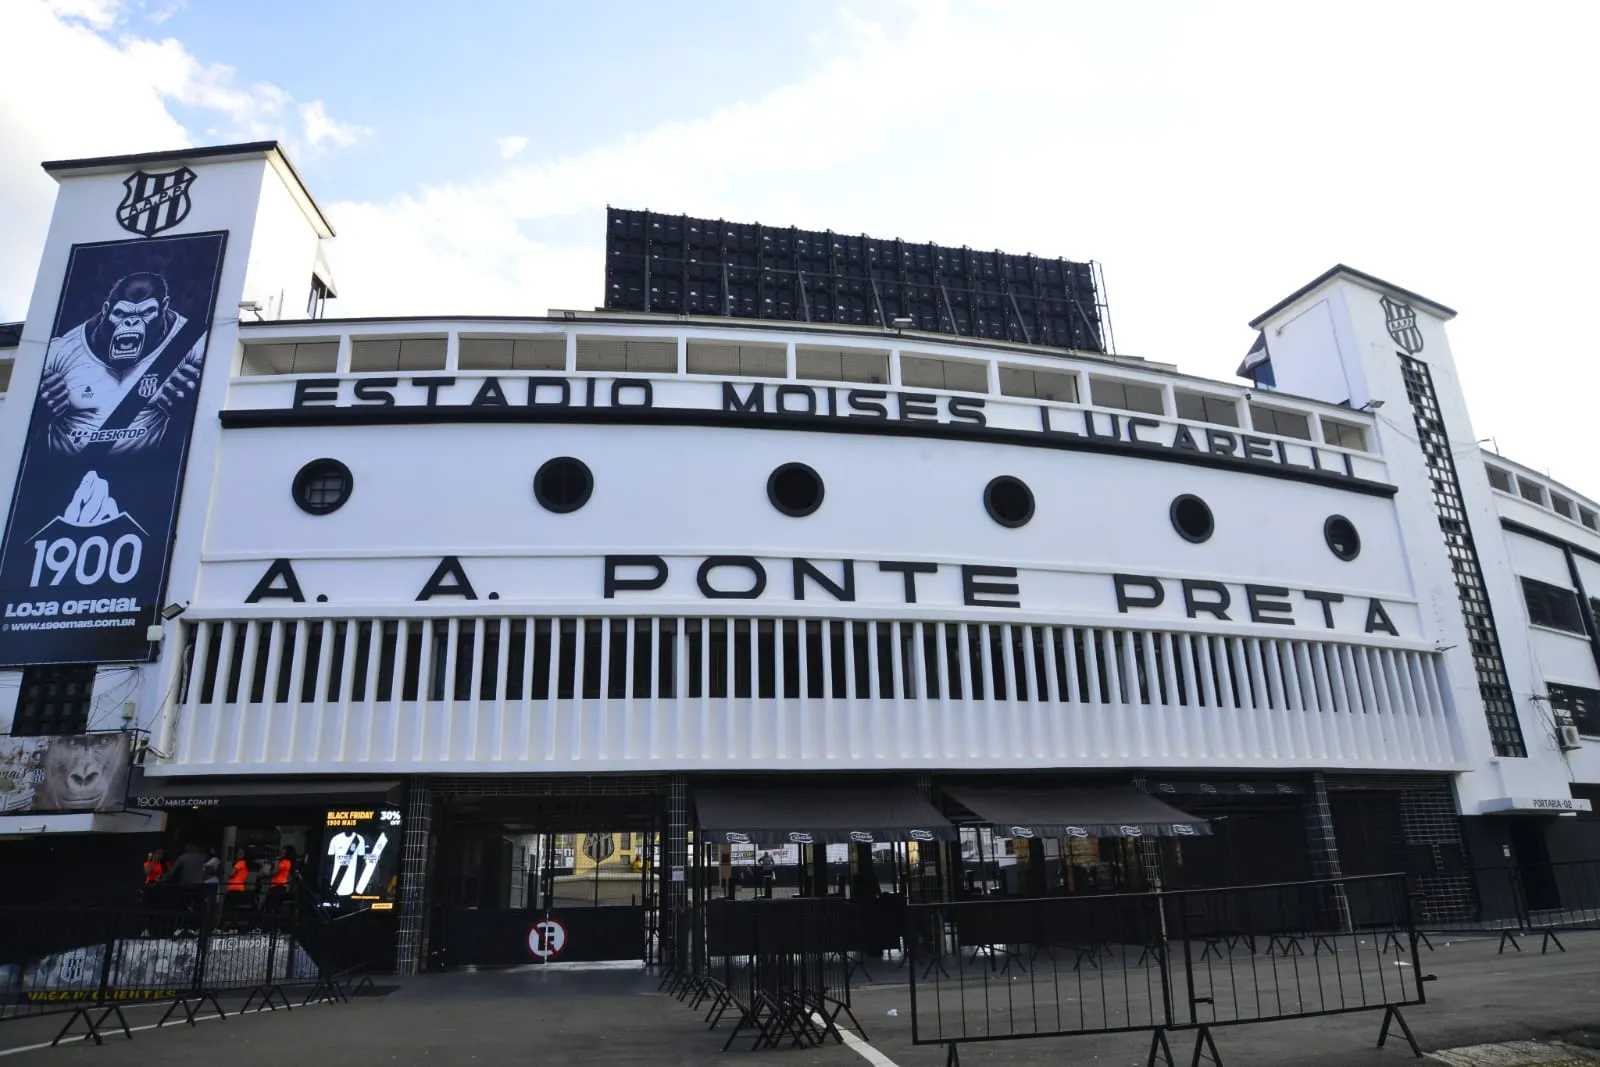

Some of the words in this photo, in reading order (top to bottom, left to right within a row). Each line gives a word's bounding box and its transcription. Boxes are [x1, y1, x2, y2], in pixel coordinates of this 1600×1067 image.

[89, 428, 146, 441] DESKTOP
[294, 377, 654, 410] ESTADIO
[722, 382, 987, 427] MOISES
[1041, 406, 1354, 477] LUCARELLI
[30, 534, 143, 587] 1900
[244, 558, 328, 603] A.
[415, 555, 500, 600] A.
[604, 555, 1021, 608] PONTE
[1113, 573, 1400, 636] PRETA
[328, 811, 348, 819] BLACK
[350, 811, 374, 819] FRIDAY
[380, 811, 401, 820] 30%
